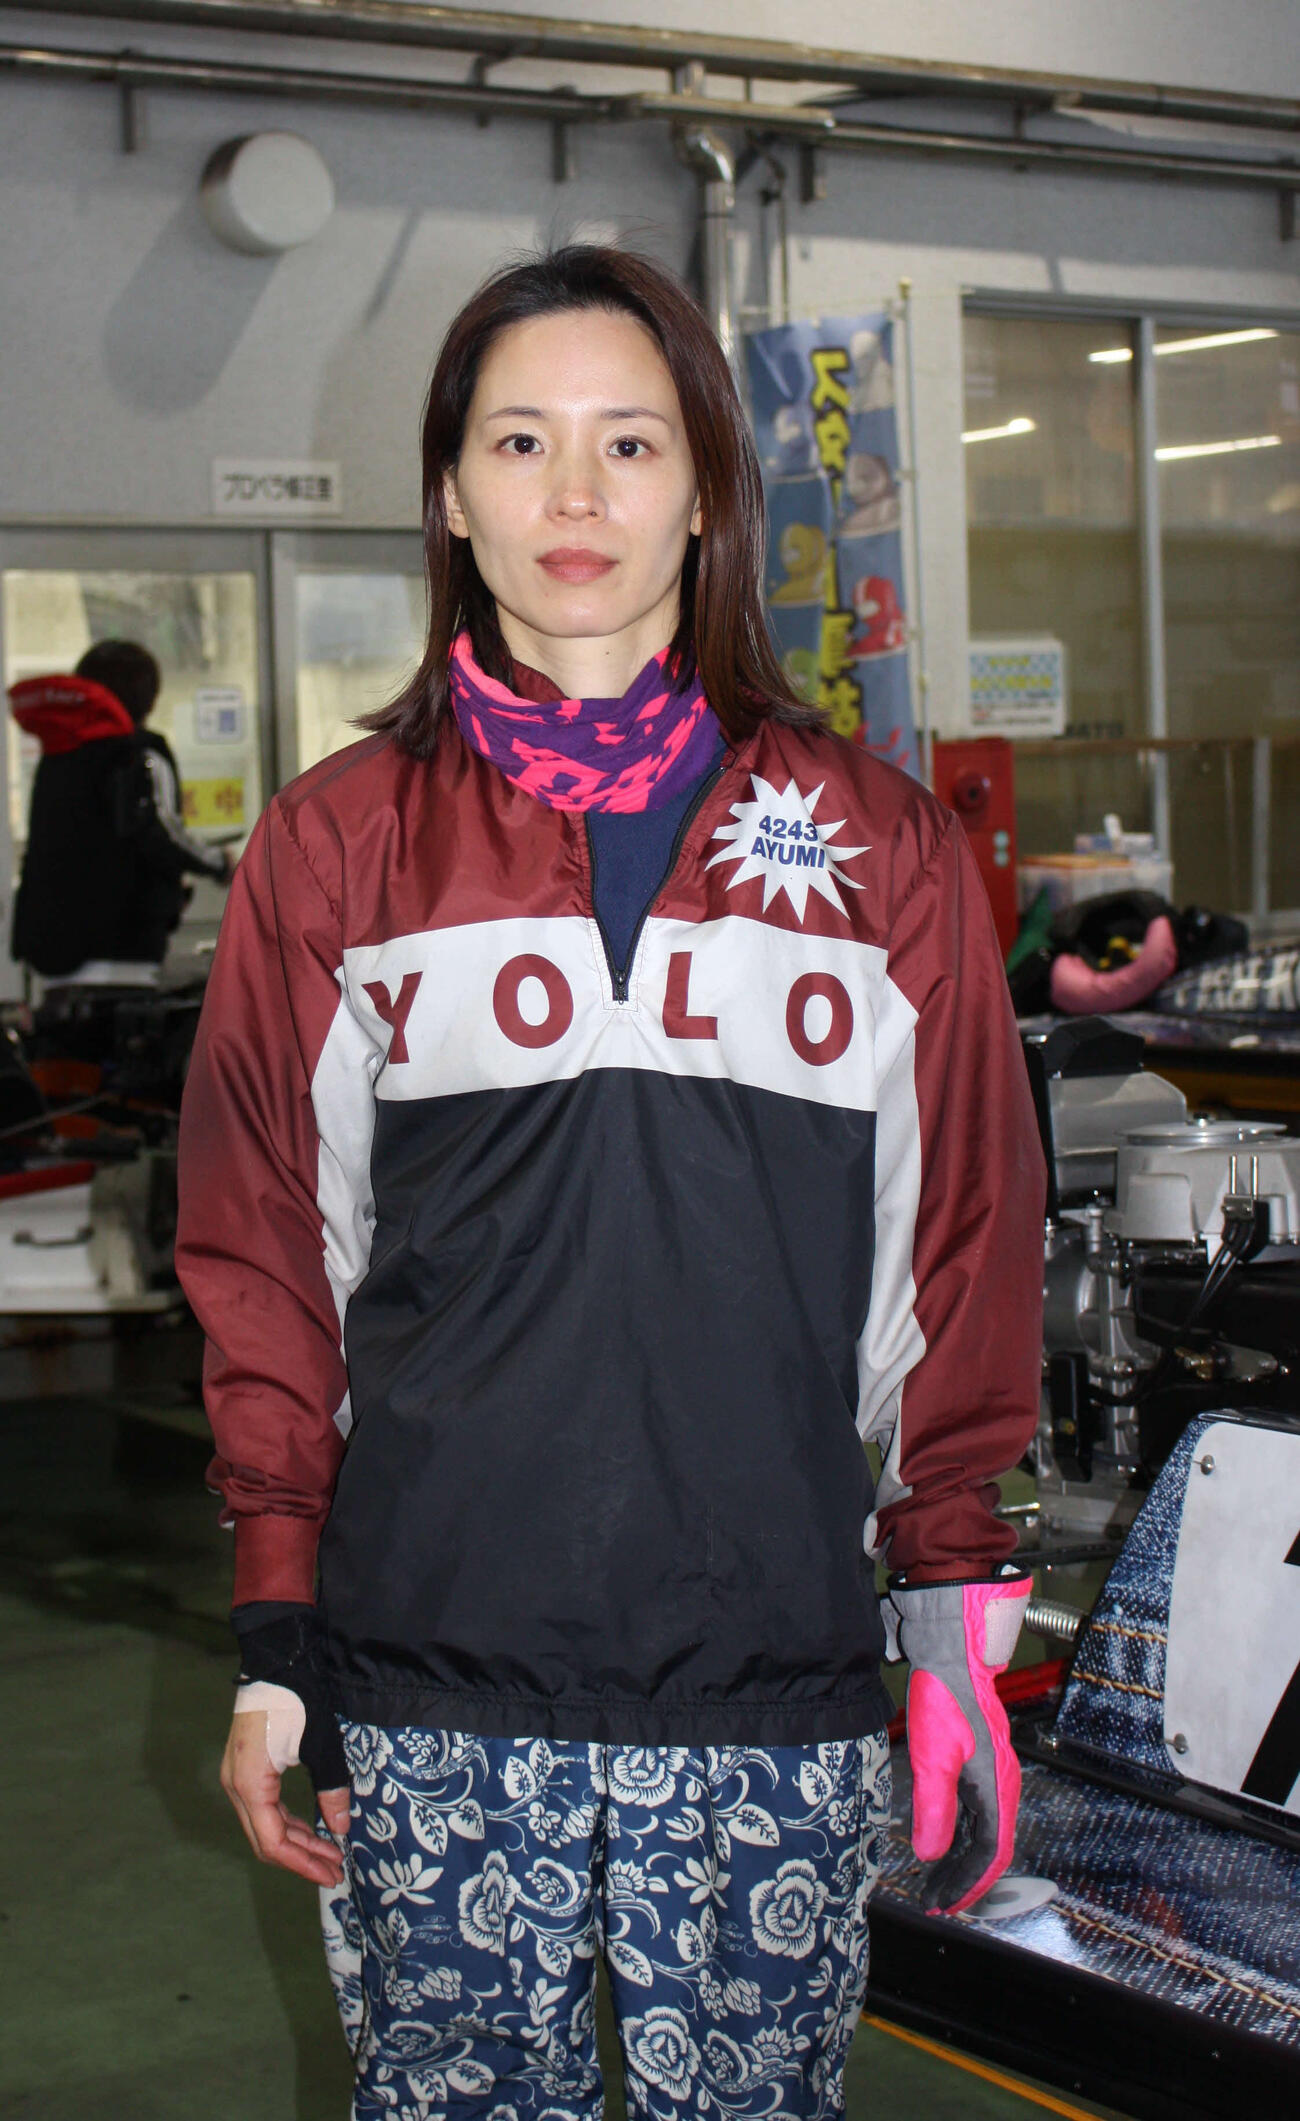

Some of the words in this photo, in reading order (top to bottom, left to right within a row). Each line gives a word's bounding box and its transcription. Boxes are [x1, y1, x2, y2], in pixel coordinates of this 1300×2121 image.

[759, 815, 819, 842] 4243
[751, 836, 825, 868] AYUMI
[362, 951, 854, 1066] YOLO
